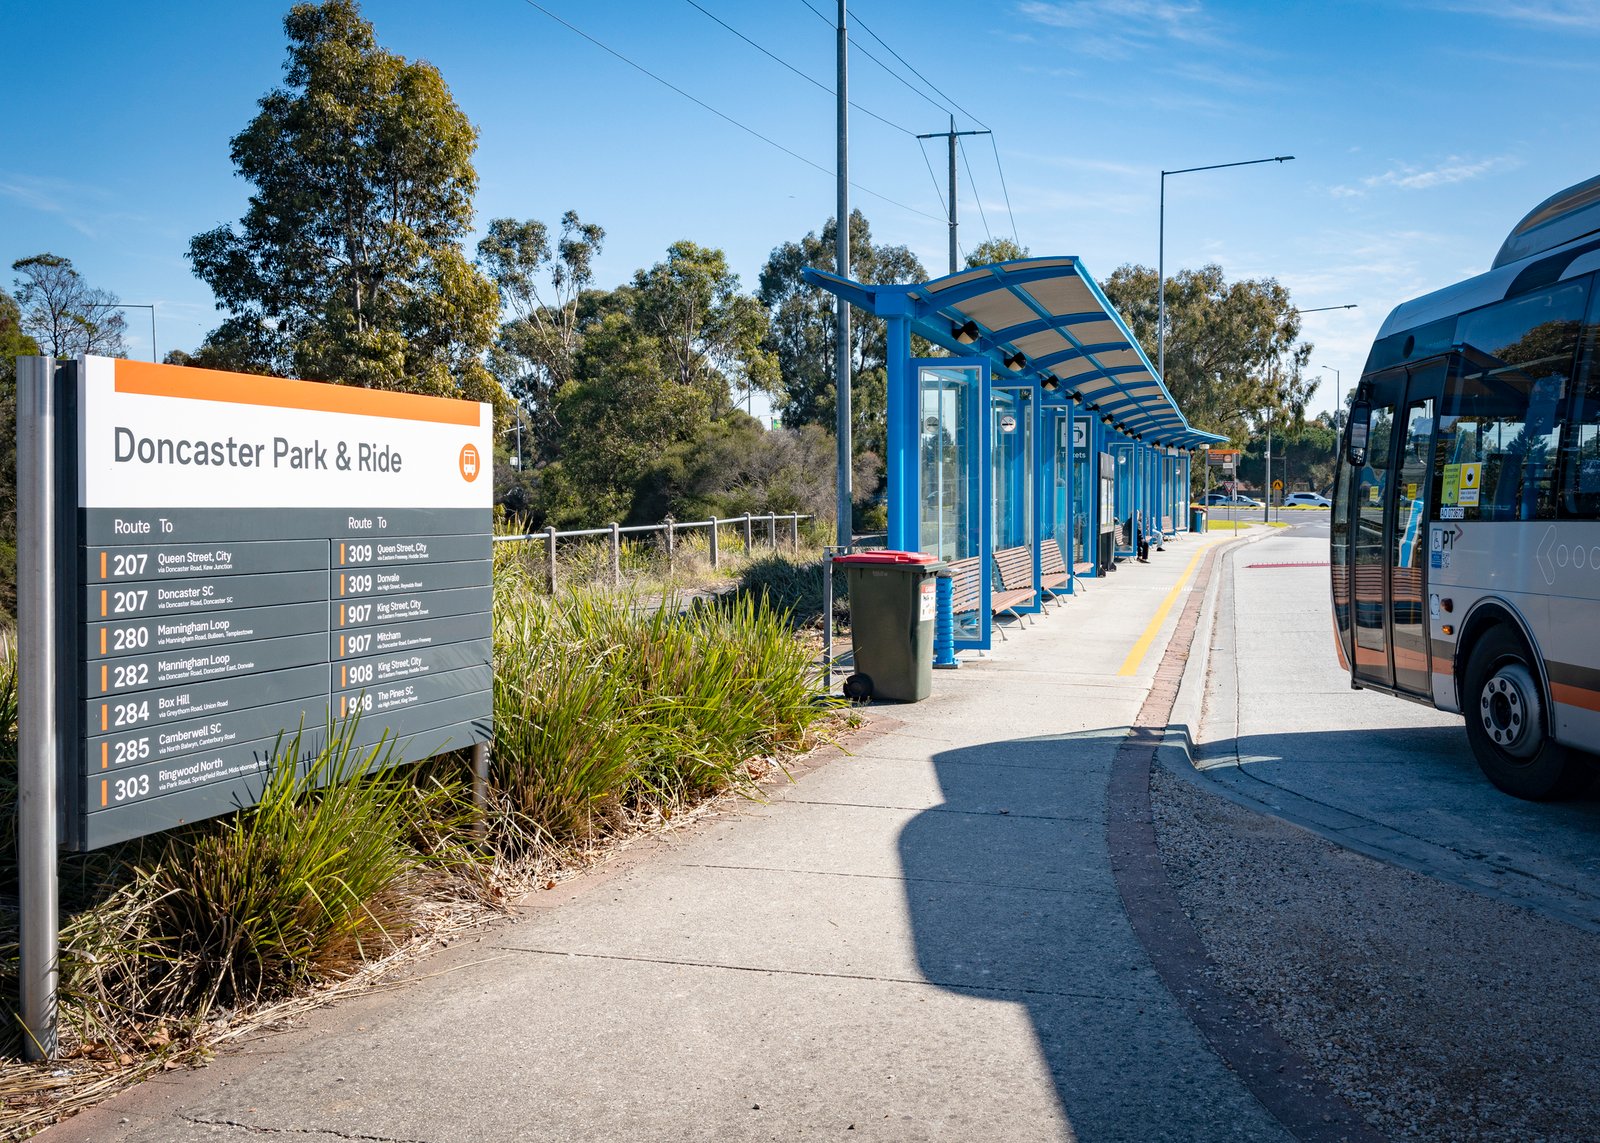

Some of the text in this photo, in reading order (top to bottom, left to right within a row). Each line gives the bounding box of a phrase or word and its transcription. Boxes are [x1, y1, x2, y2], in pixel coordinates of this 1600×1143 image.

[114, 426, 402, 474] Doncaster Park & Ride
[115, 518, 173, 534] Route To
[348, 517, 386, 529] Route To
[377, 543, 427, 554] Queen Street, City
[1443, 530, 1455, 550] PT
[158, 551, 232, 565] Queen Street, City
[349, 545, 371, 562] 309
[114, 554, 147, 576] 207
[349, 575, 371, 593] 309
[377, 573, 399, 583] Donvale
[114, 591, 148, 612] 207
[158, 586, 214, 600] Doncaster SC
[348, 605, 371, 623] 907
[377, 600, 421, 613] King Street, City
[158, 620, 230, 635] Manningham Loop
[114, 627, 148, 650] 280
[165, 636, 194, 644] Manningham
[226, 629, 253, 637] Templestowe
[348, 635, 371, 654] 907
[377, 631, 401, 642] Mitcham
[158, 655, 230, 672] Manningham Loop
[378, 657, 422, 672] King Street, City
[114, 664, 148, 688] 282
[166, 672, 189, 680] Doncaster
[203, 667, 226, 675] Doncaster
[350, 664, 372, 684] 908
[159, 694, 190, 709] Box Hill
[378, 686, 413, 701] The Pines SC
[114, 701, 149, 726] 284
[167, 708, 190, 717] Greythorn
[159, 723, 222, 745] Camberwell SC
[115, 738, 149, 763] 285
[166, 744, 180, 753] North
[199, 735, 224, 746] Canterbury
[159, 758, 223, 781] Ringwood North
[192, 772, 216, 783] Springfield
[115, 775, 149, 801] 303
